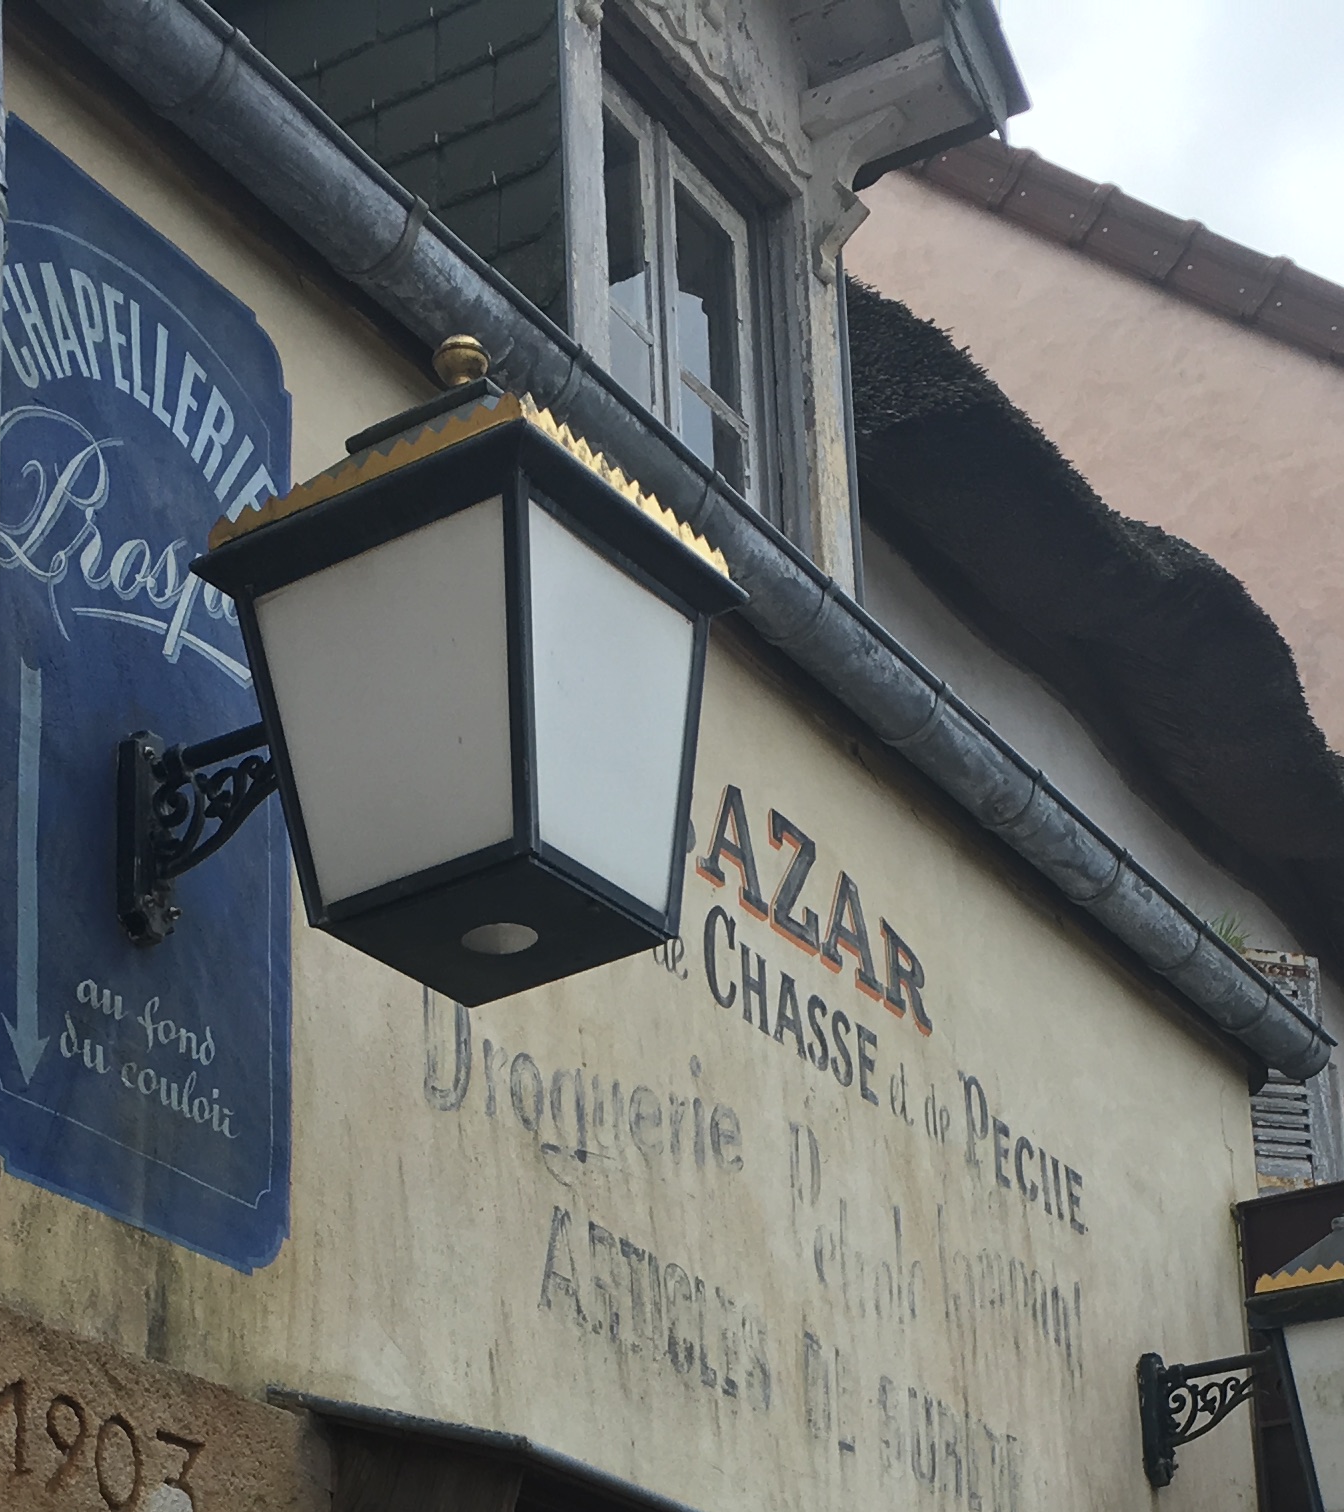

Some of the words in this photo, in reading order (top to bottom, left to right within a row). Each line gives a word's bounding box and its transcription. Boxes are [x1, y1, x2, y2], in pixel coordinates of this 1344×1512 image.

[687, 783, 934, 1037] AZAR
[59, 1010, 112, 1075] du
[120, 1070, 240, 1139] couloir
[76, 978, 128, 1020] au
[136, 996, 216, 1066] fond
[703, 905, 879, 1107] CHASSE
